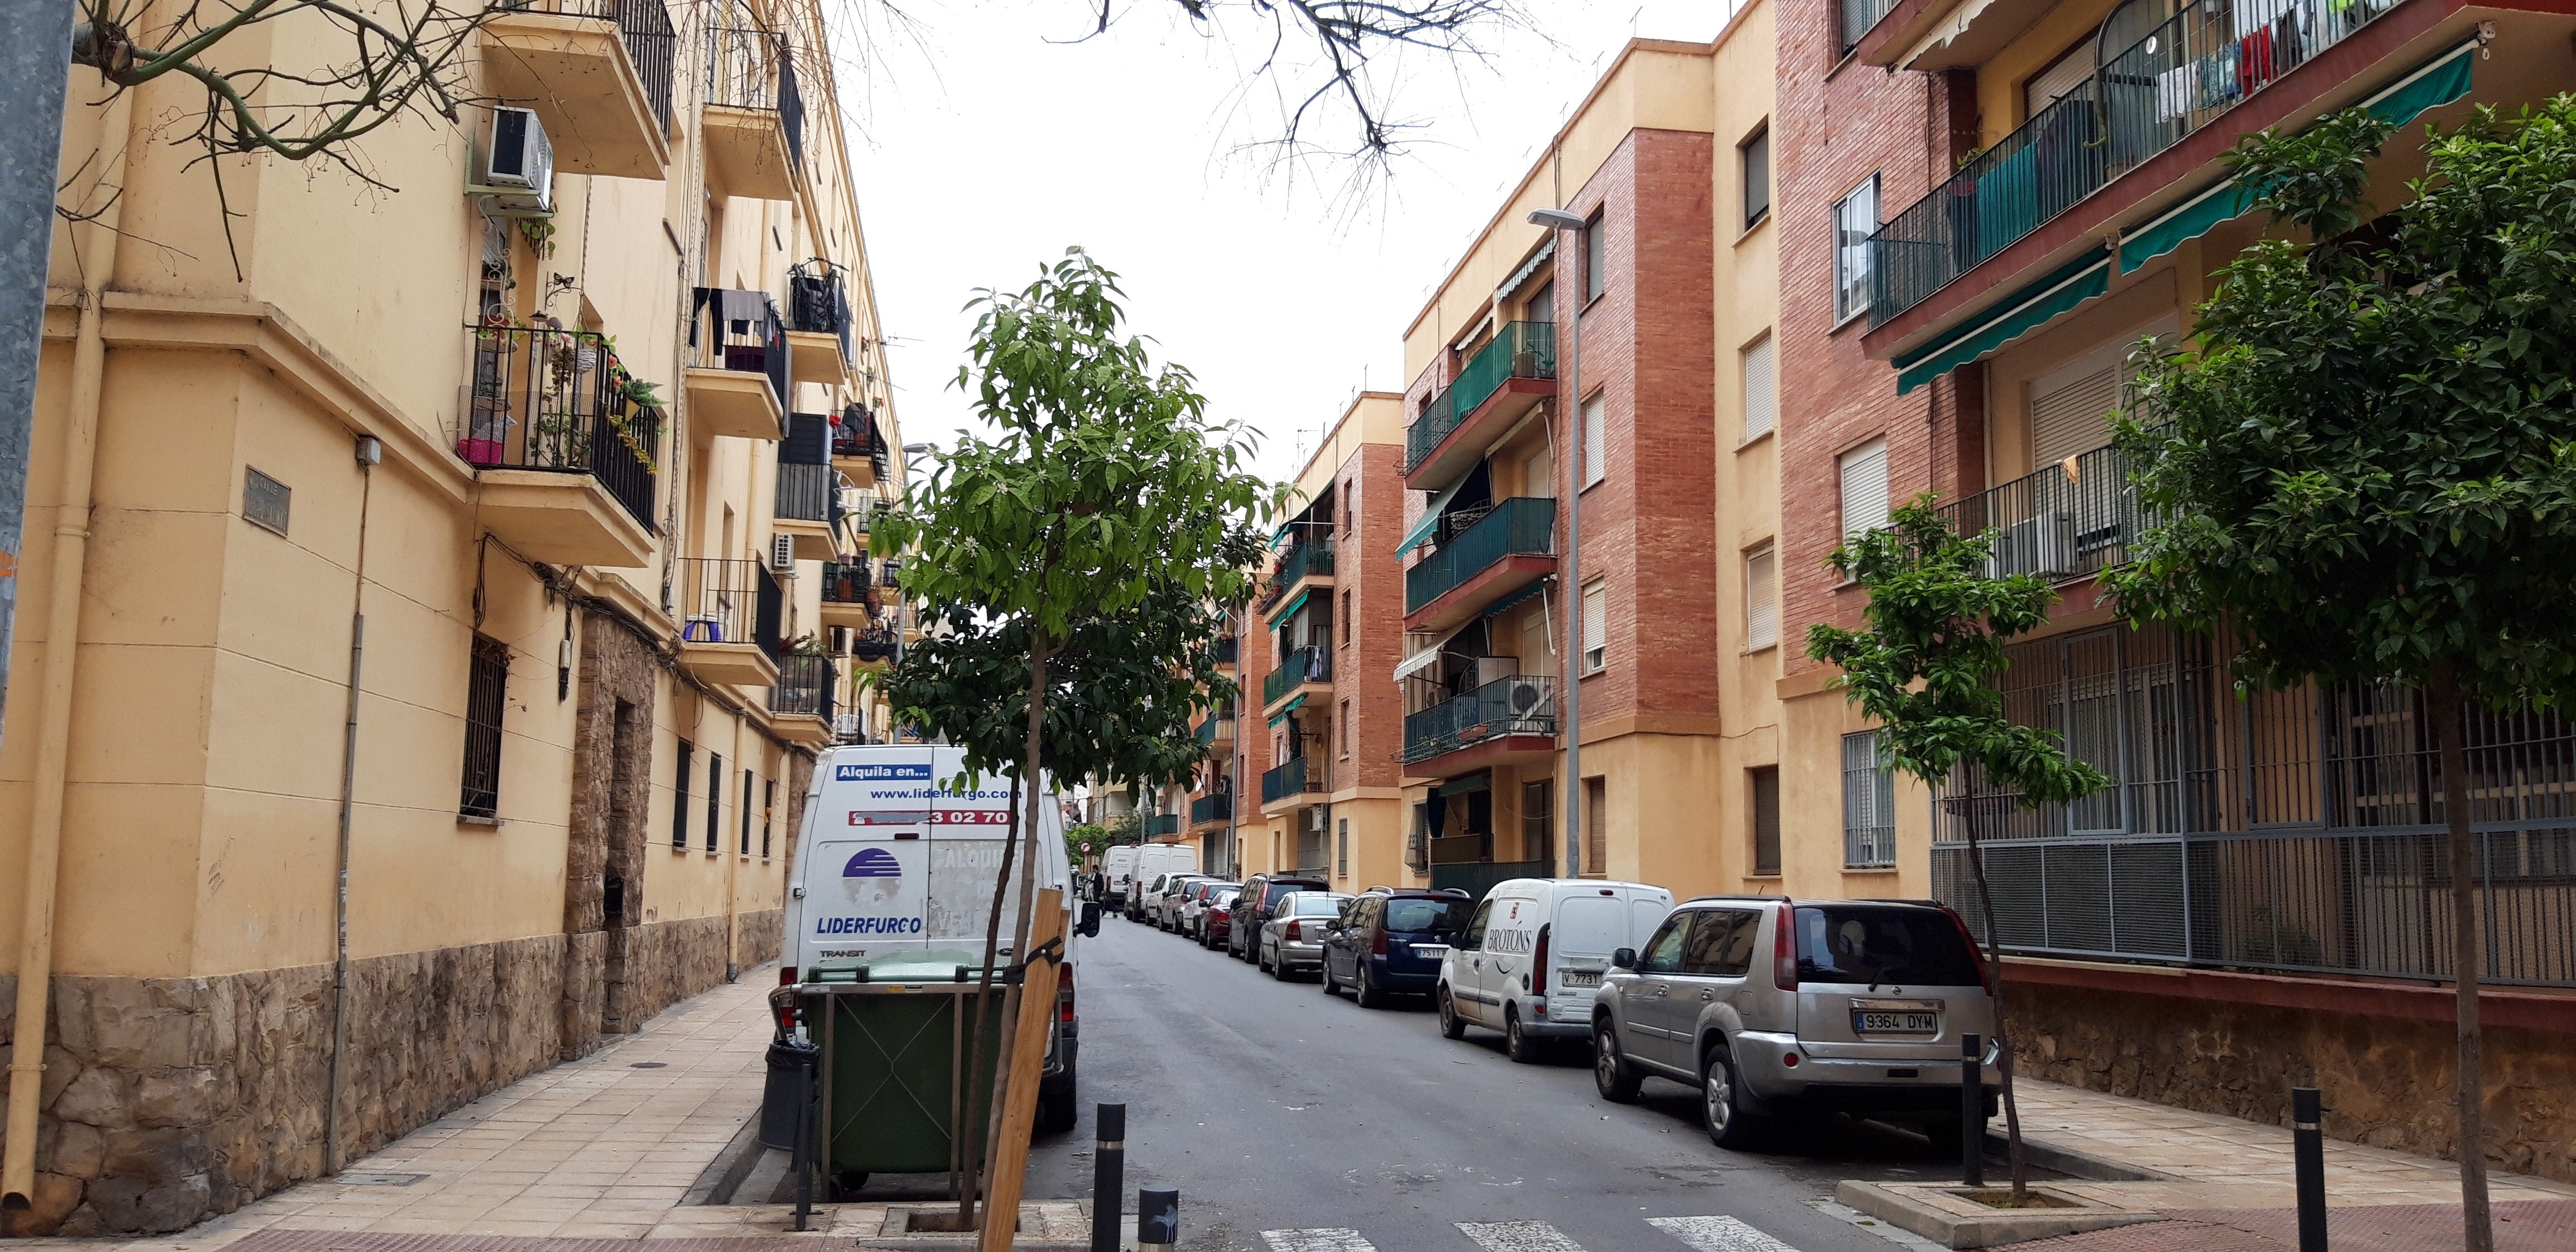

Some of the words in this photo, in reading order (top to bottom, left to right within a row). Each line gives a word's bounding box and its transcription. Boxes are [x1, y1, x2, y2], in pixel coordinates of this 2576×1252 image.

[840, 766, 892, 779] Alquila
[896, 768, 928, 776] en...
[950, 812, 976, 823] 02
[983, 812, 1008, 823] 70
[817, 917, 921, 934] LIDERFURGO
[1488, 920, 1532, 952] BROTÓNS
[1866, 1014, 1900, 1028] 9364
[1907, 1015, 1933, 1029] DYM
